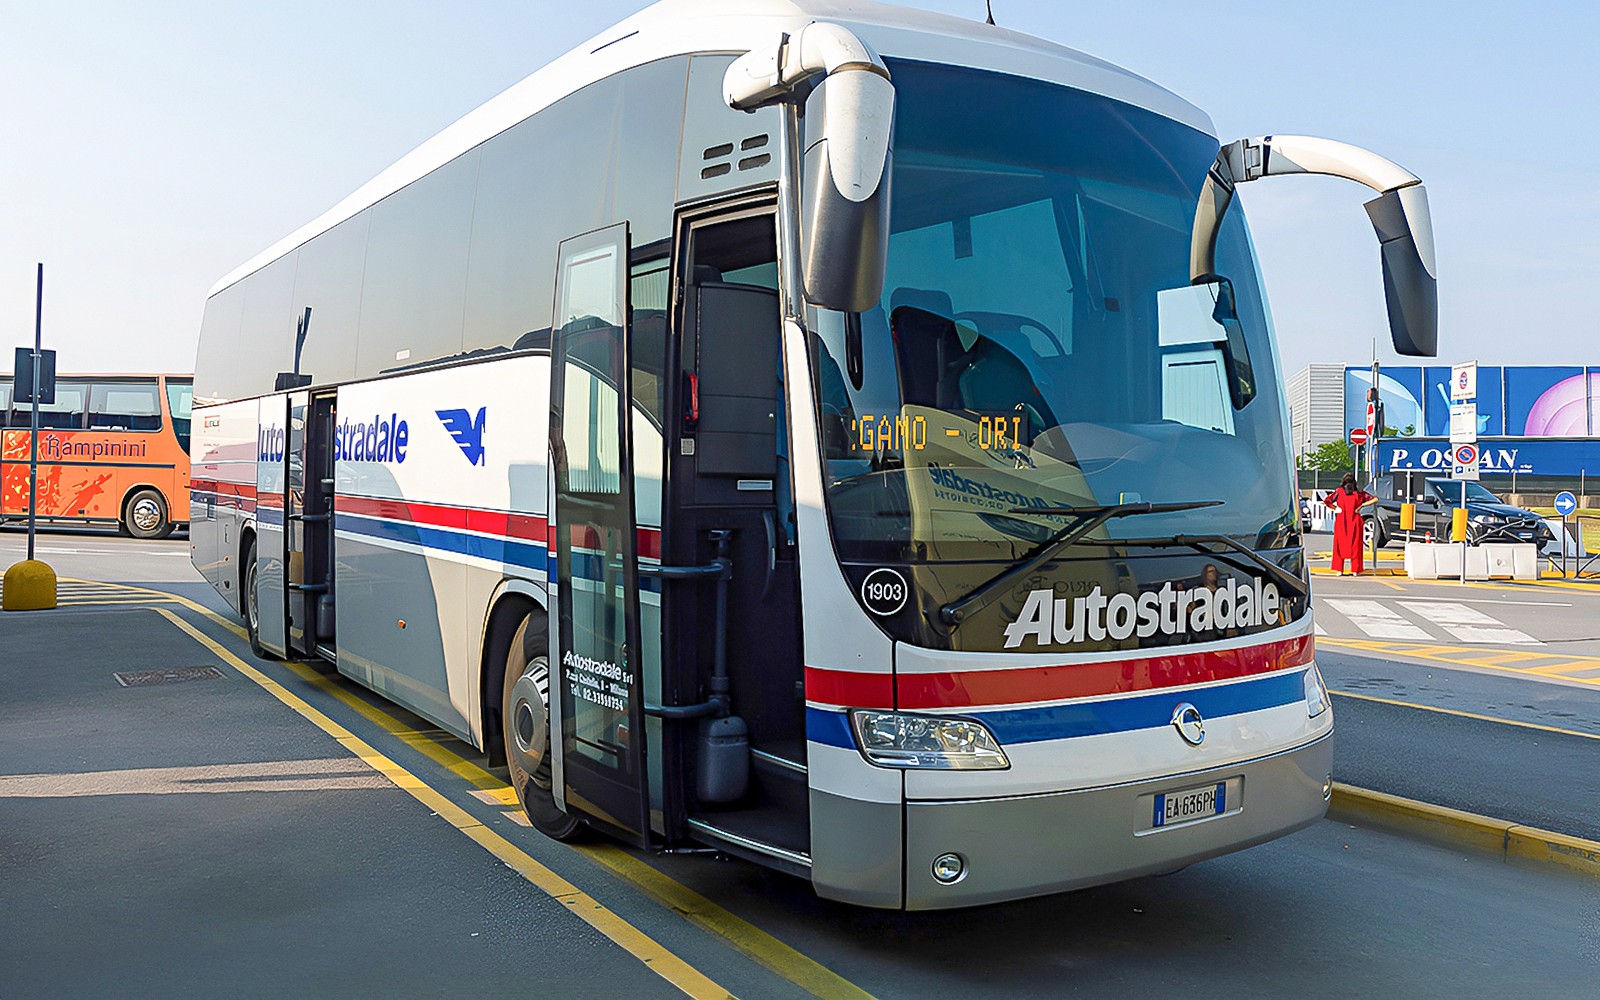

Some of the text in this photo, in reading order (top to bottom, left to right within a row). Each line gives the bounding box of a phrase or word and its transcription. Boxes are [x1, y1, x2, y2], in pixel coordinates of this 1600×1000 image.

[46, 434, 146, 460] Rampinini
[978, 416, 1021, 450] ORI
[1391, 449, 1413, 468] P.
[867, 583, 902, 601] 1903
[1003, 576, 1280, 649] Autostradale
[563, 650, 622, 681] Autostradale
